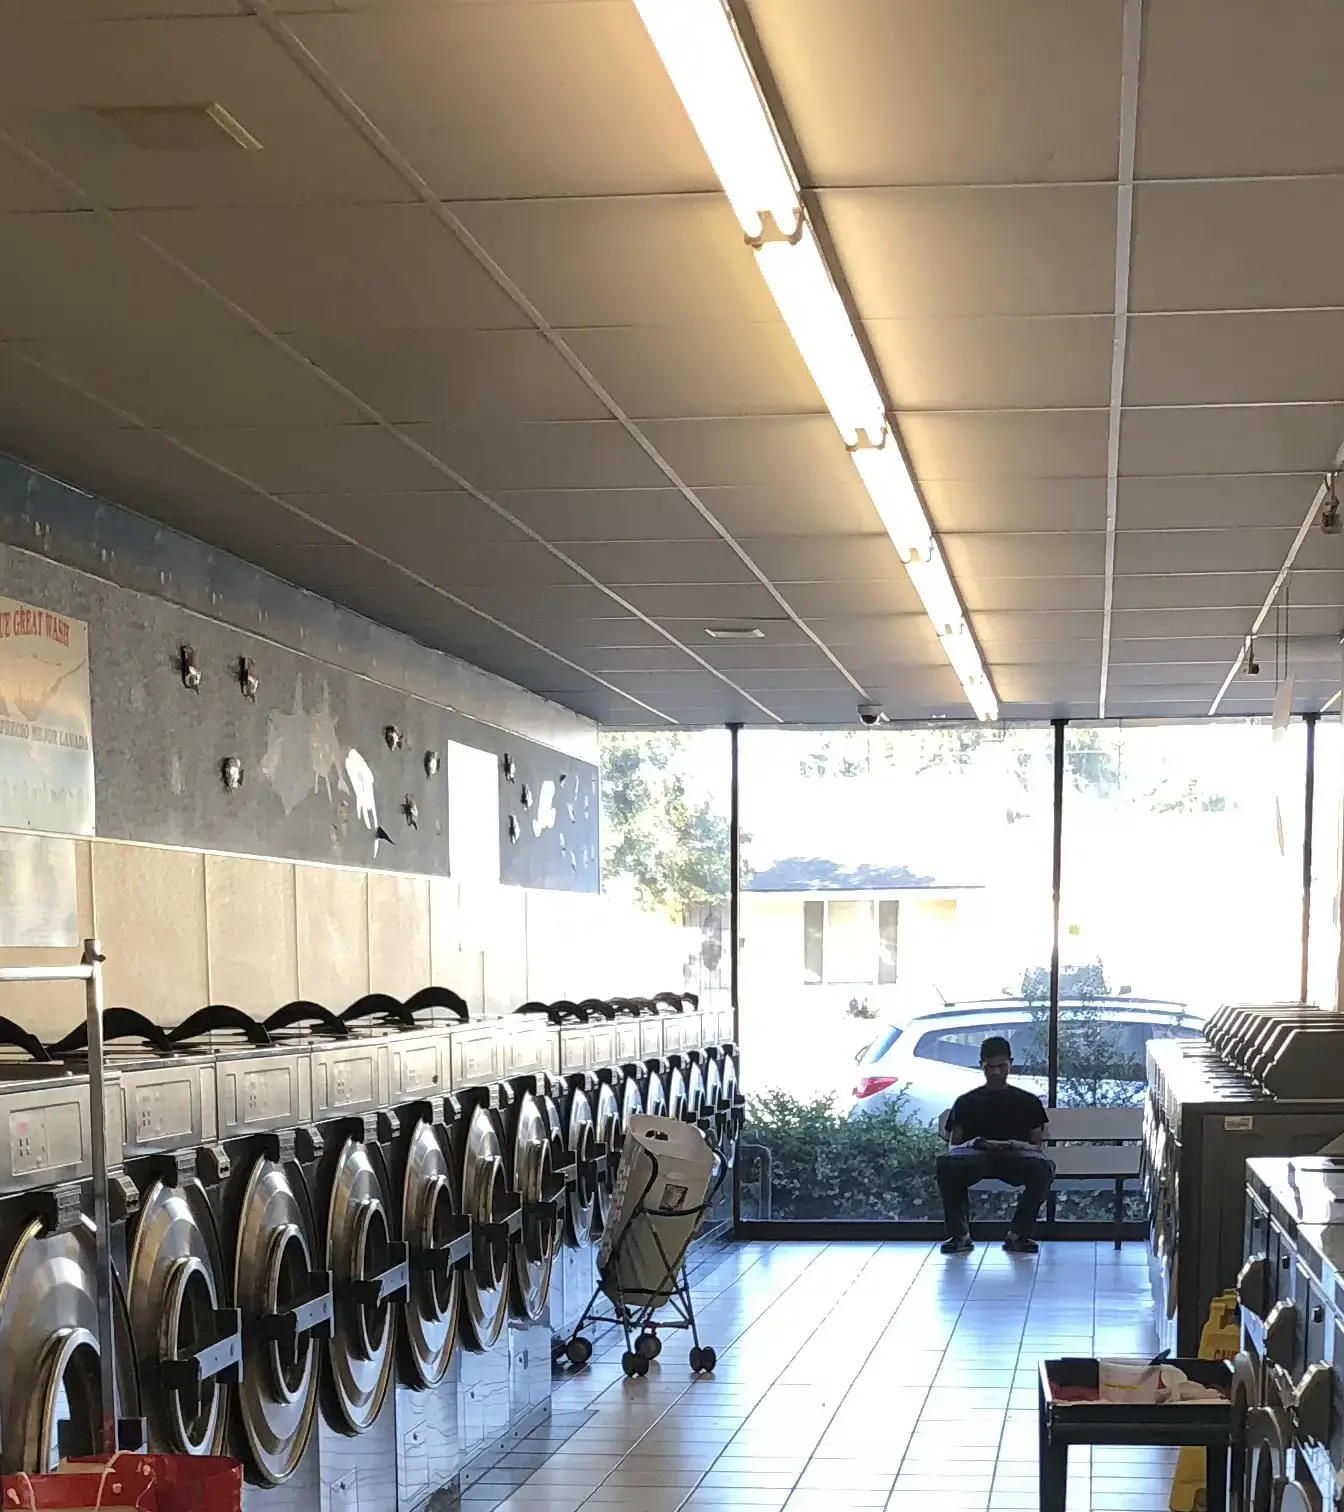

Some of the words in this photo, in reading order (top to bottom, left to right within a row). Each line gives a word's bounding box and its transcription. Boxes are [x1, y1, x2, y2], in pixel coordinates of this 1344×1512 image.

[13, 609, 44, 637] GREAT
[46, 611, 70, 648] WASH
[0, 718, 29, 740] PRECIO
